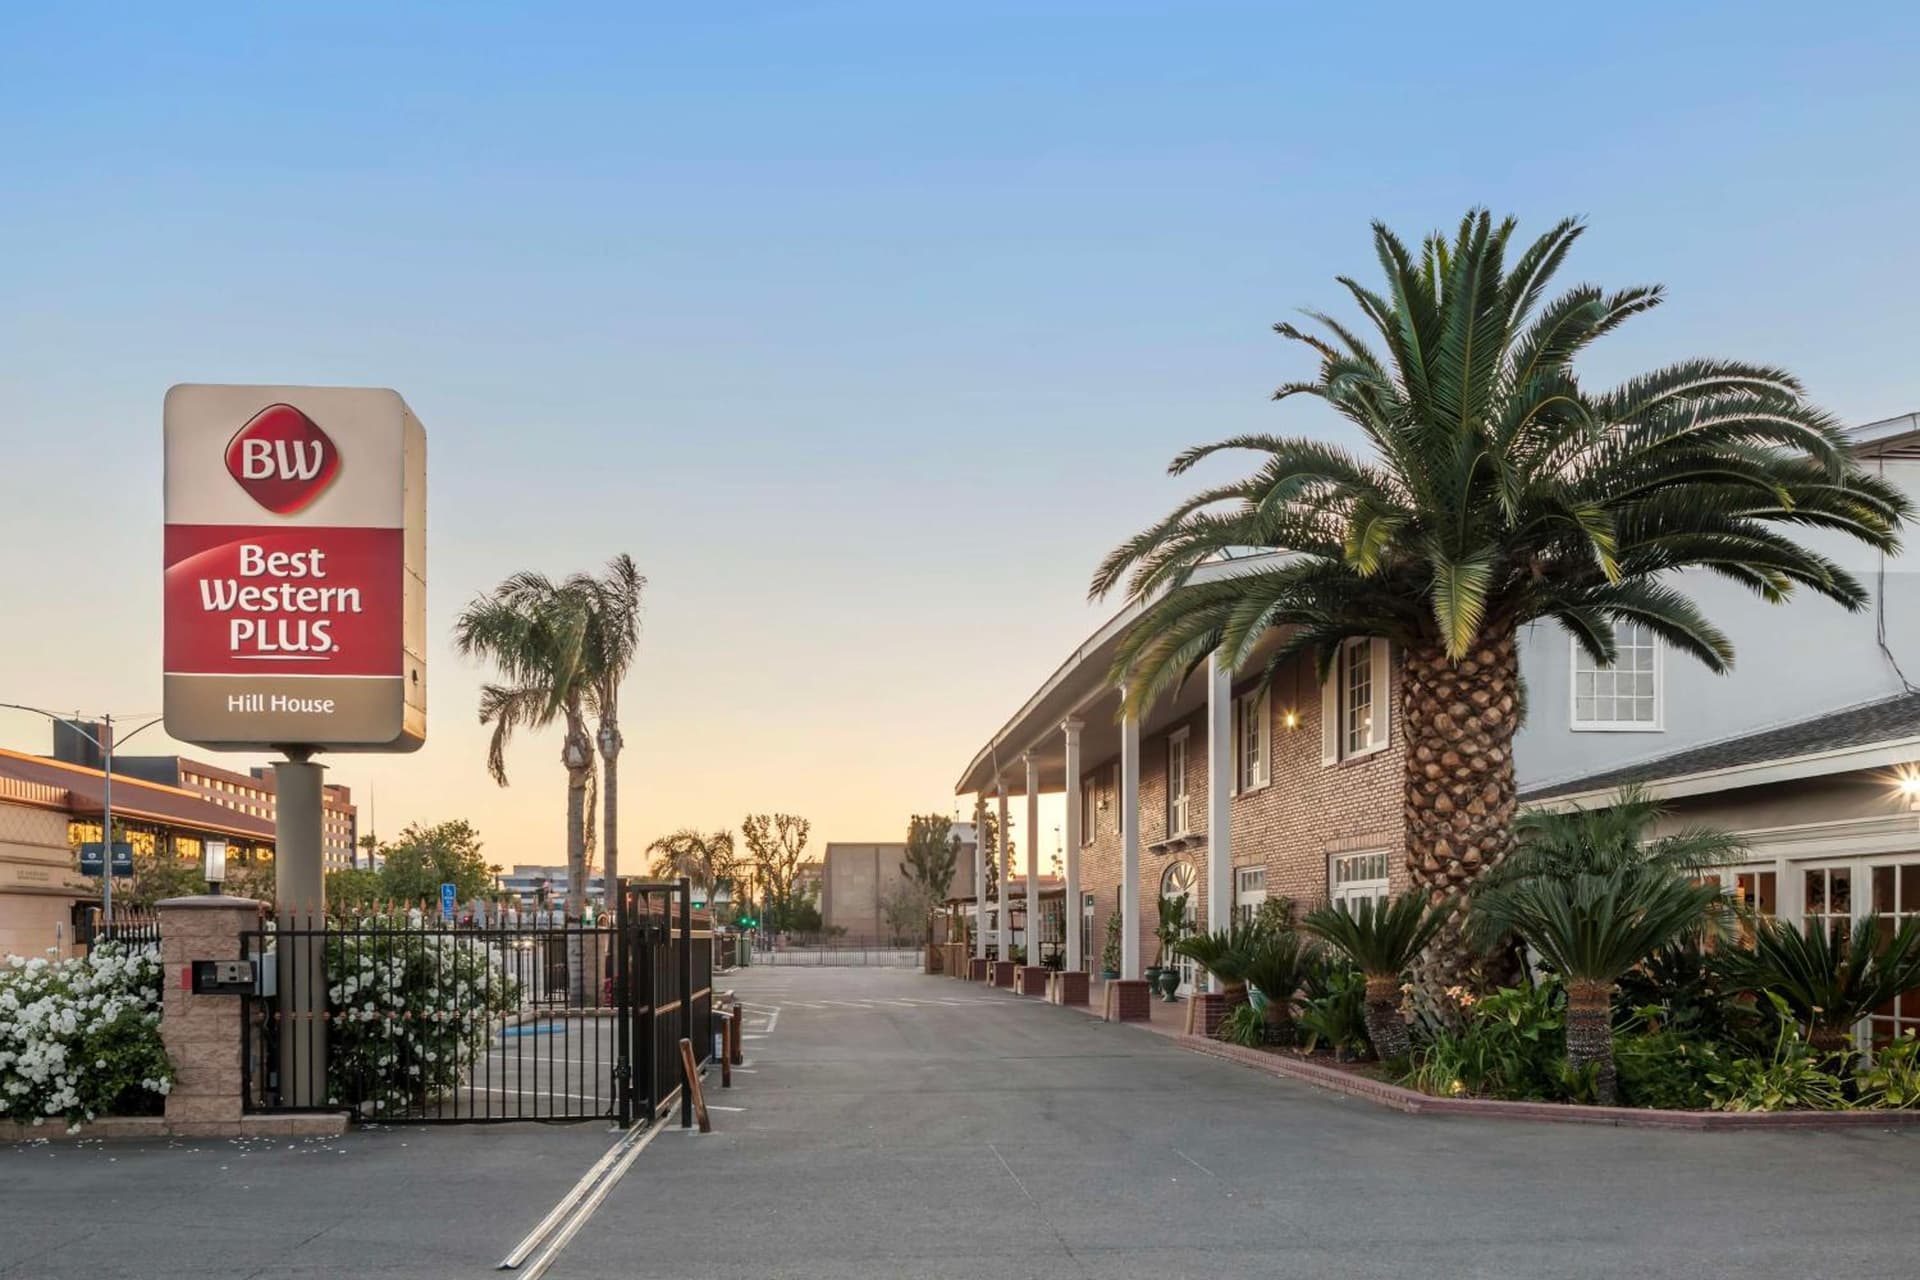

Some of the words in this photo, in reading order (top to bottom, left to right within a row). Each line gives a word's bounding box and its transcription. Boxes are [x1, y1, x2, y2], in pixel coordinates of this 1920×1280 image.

[242, 438, 323, 480] BW
[239, 544, 326, 577] Best
[200, 579, 362, 613] Western
[228, 694, 265, 713] Hill
[270, 694, 335, 713] House
